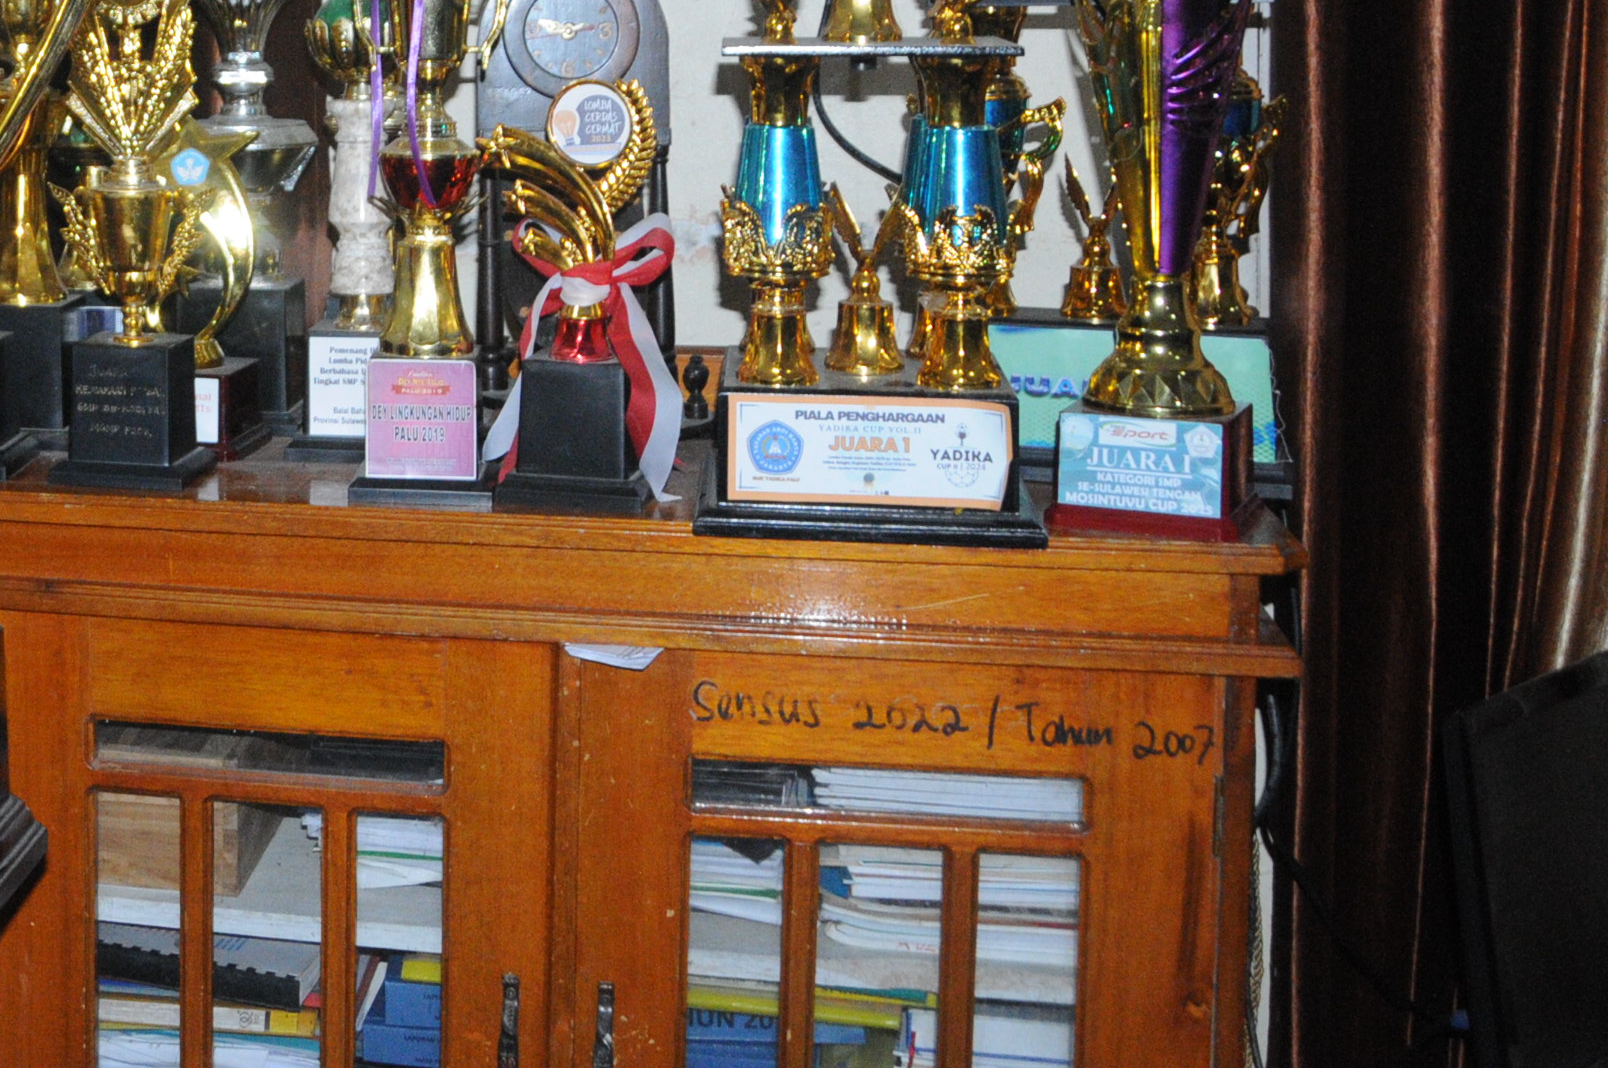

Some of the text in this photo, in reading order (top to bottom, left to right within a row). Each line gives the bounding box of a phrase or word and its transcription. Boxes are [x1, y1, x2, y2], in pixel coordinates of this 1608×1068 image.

[599, 22, 612, 39] 3
[584, 99, 612, 110] LOMBA
[585, 111, 618, 122] CERDAS
[586, 122, 622, 134] CERMAT
[372, 405, 471, 421] DEY LINGKUNGAN HIDUP
[795, 410, 945, 424] PIALA PENGHARGAAN
[395, 426, 445, 442] PALU 2019
[819, 424, 859, 433] YADIKA
[863, 425, 882, 433] CUP
[829, 436, 911, 453] JUARA 1
[930, 449, 993, 464] YADIKA
[1086, 447, 1177, 473] JUARA
[1097, 472, 1181, 487] KATEGORI SMP
[1078, 482, 1201, 501] SE-SULAWESI TENGAH
[1065, 492, 1146, 511] MOSINTUVU
[1148, 499, 1177, 512] CUP
[692, 680, 820, 728] Sensus
[1133, 721, 1214, 766] 2007
